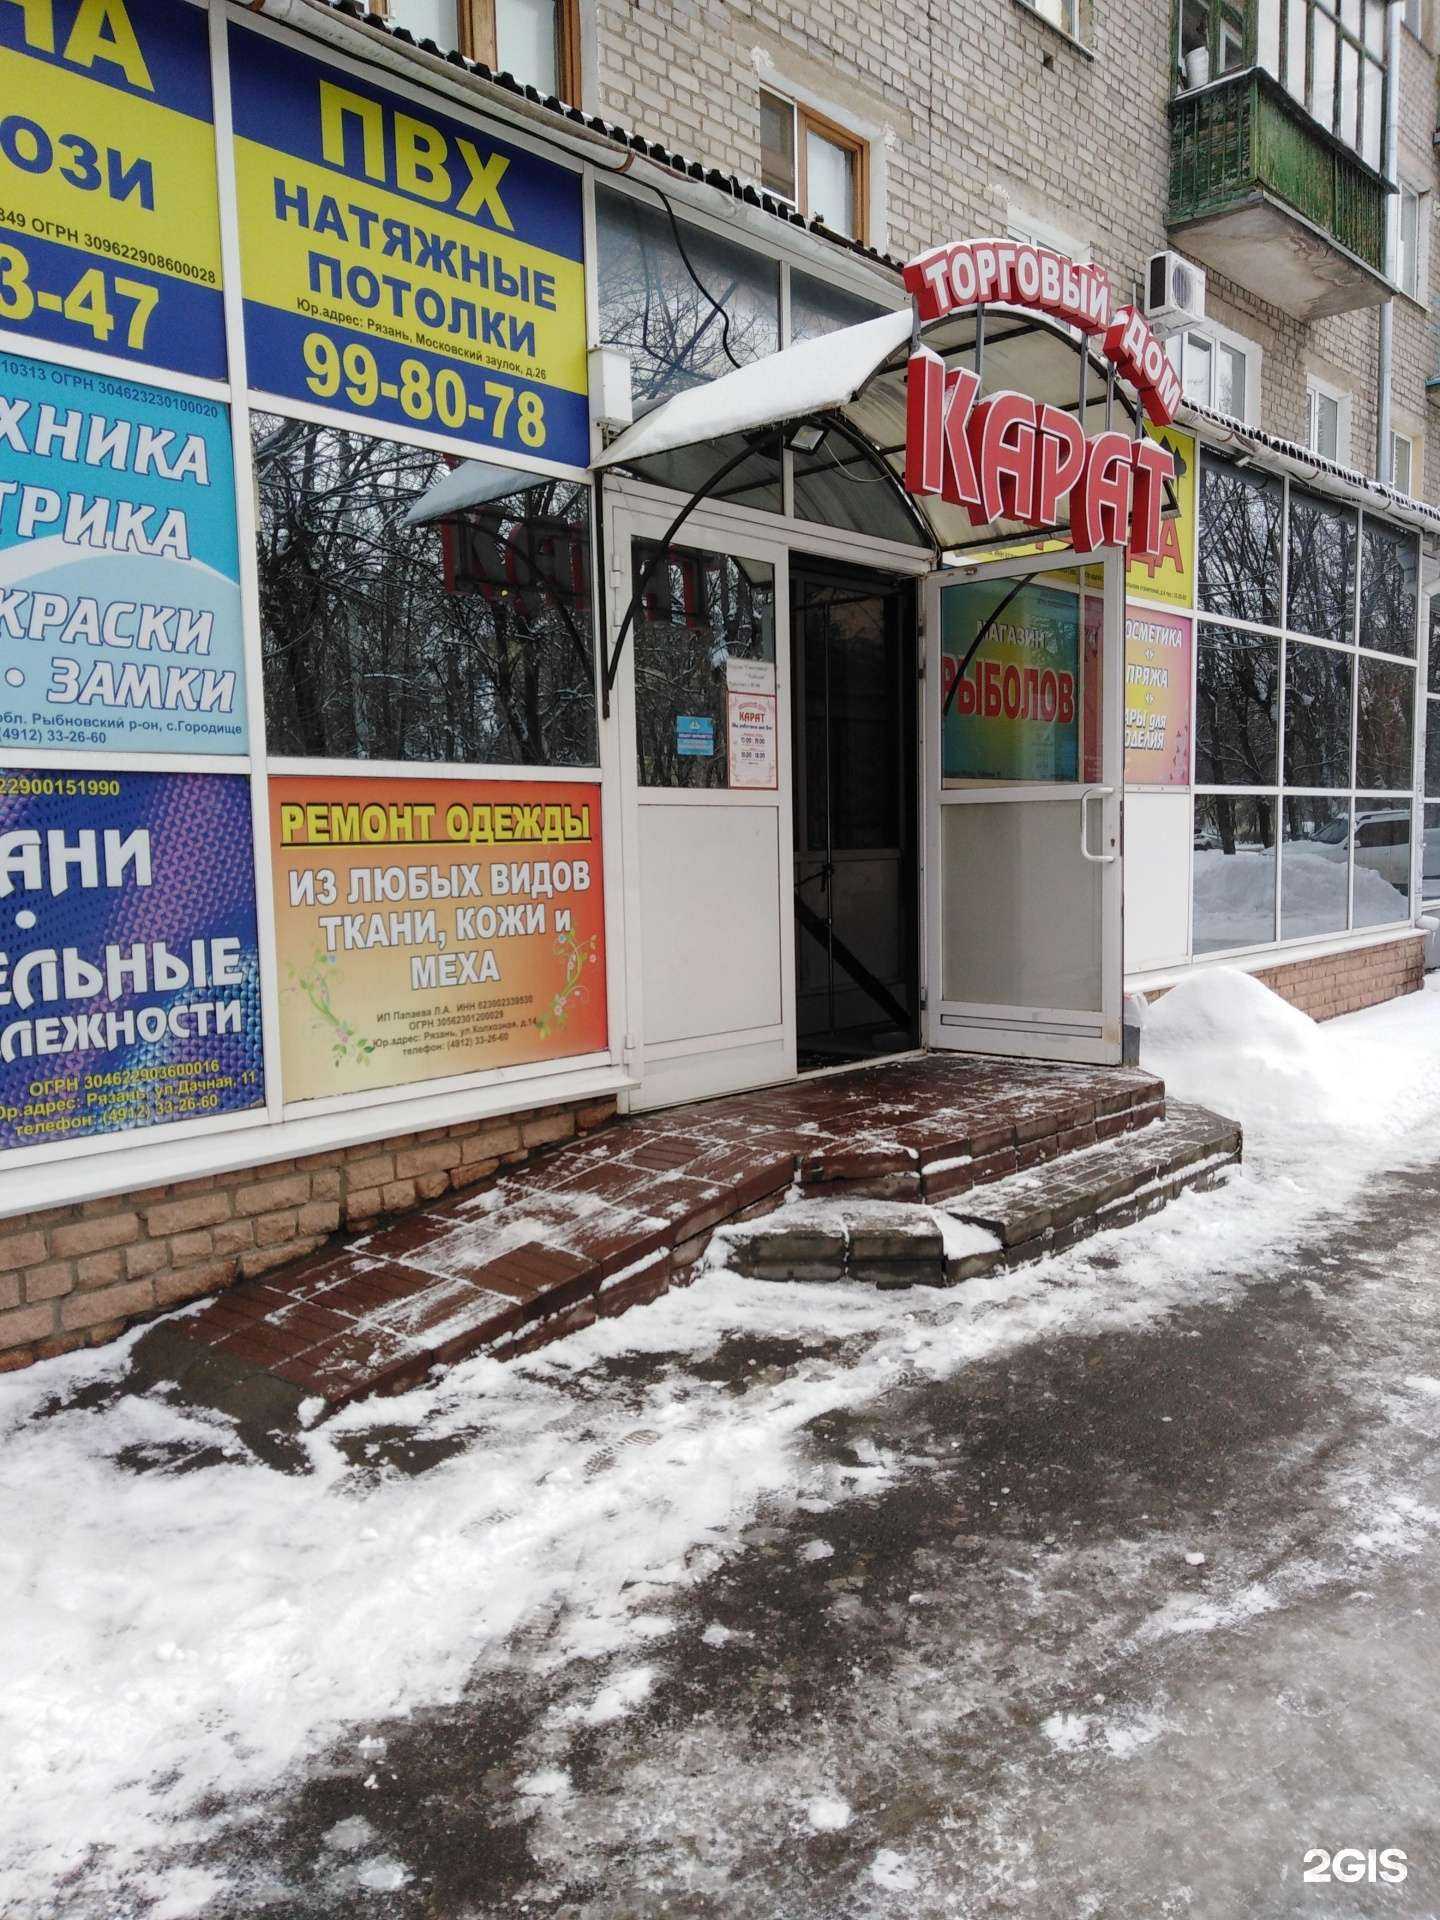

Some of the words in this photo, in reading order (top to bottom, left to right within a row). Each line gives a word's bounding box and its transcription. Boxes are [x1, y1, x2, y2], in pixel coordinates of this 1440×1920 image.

[0, 115, 155, 212] ОЗИ
[319, 79, 515, 232] ПВХ
[32, 217, 79, 243] ОГРН
[84, 233, 216, 284] 309622908600028
[273, 176, 557, 312] НАТЯЖНЫЕ
[0, 242, 160, 350] 3-47
[307, 250, 537, 358] ПОТОЛКИ
[908, 243, 1111, 331] ТОРГОВЫЙ
[296, 297, 363, 327] Юр.адрес:
[367, 318, 413, 343] Рязань,
[415, 332, 483, 362] Московский
[485, 354, 523, 375] заулок,
[525, 367, 546, 380] д.26
[1114, 305, 1184, 424] ДОМ
[51, 369, 95, 392] ОГРН
[302, 332, 546, 448] 99-80-78
[0, 395, 211, 487] ХНИКА
[907, 354, 1175, 555] КАРАТ
[0, 587, 216, 656] КРАСКИ
[46, 656, 237, 714] ЗАМКИ
[1126, 663, 1169, 689] ПРЯЖА
[32, 712, 125, 729] Рыбновский
[129, 719, 163, 733] р-он,
[166, 720, 243, 736] с.Городище
[47, 729, 107, 744] 33-26-60
[280, 803, 437, 844] РЕМОНТ
[446, 802, 590, 846] ОДЕЖДЫ
[0, 829, 153, 898] АНИ
[288, 869, 338, 907] ИЗ
[347, 863, 482, 905] ЛЮБЫХ
[489, 859, 591, 899] ВИДОВ
[318, 909, 448, 951] ТКАНИ,
[456, 903, 546, 941] КОЖИ
[555, 909, 572, 932] и
[410, 950, 502, 991] МЕХА
[409, 1019, 434, 1031] ОГРН
[30, 1077, 79, 1097] ОГРН
[155, 1093, 219, 1117] 33-26-60
[241, 1070, 257, 1084] 11
